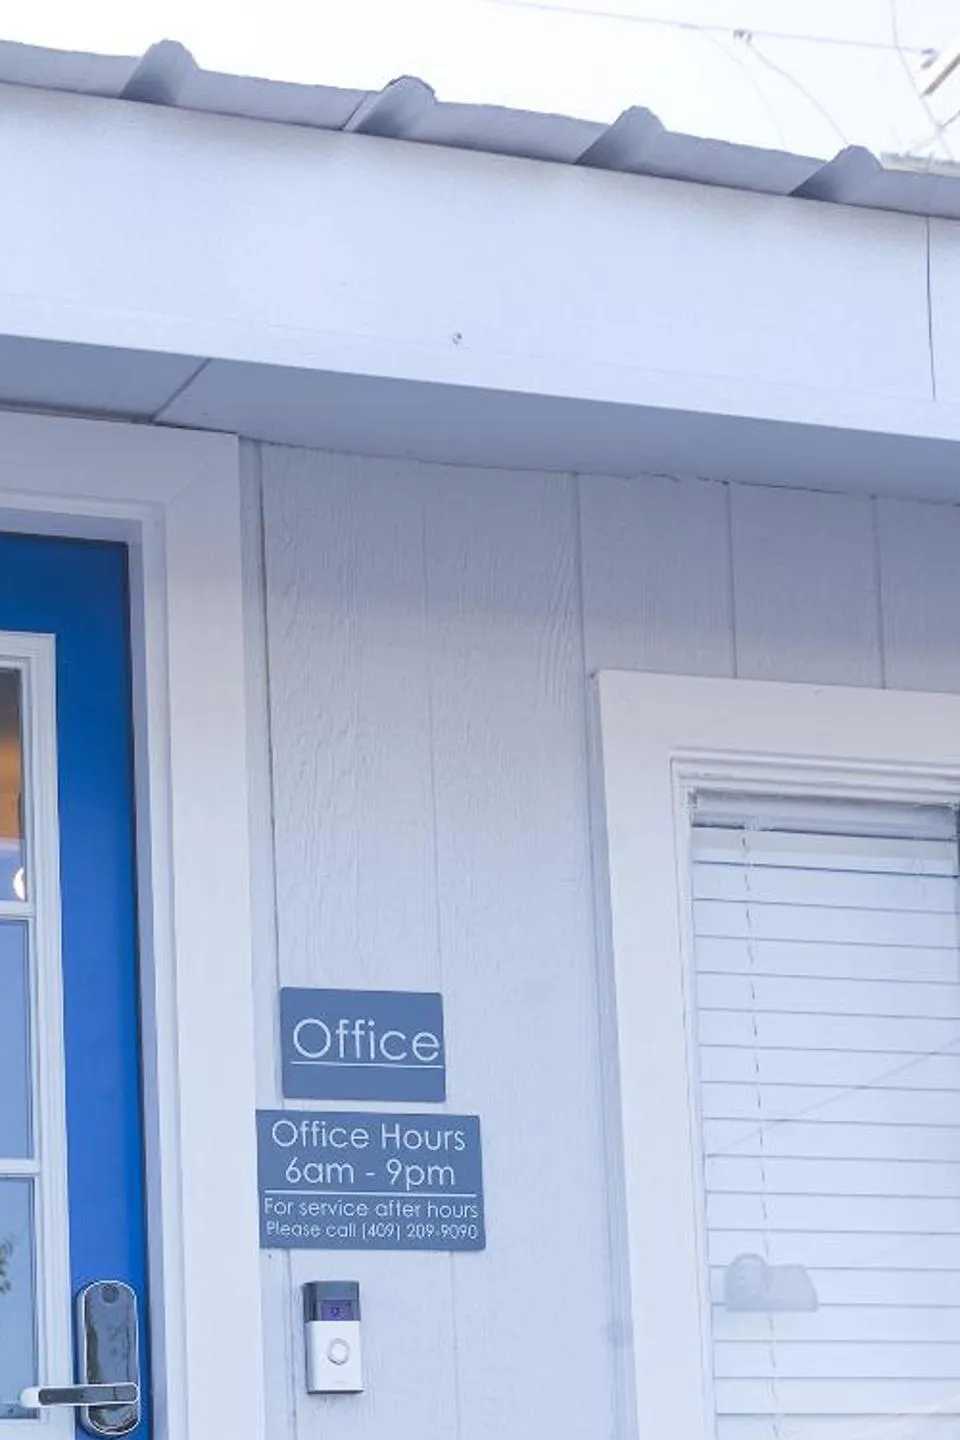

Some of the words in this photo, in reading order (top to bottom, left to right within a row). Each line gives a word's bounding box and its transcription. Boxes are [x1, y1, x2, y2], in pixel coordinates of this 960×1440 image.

[293, 1018, 440, 1062] Office
[272, 1119, 370, 1149] Office
[381, 1123, 466, 1151] Hours
[285, 1156, 354, 1184] 6am
[386, 1158, 455, 1191] 9pm
[264, 1198, 294, 1215] For
[299, 1199, 369, 1217] service
[375, 1199, 421, 1217] after
[427, 1200, 479, 1218] hours
[266, 1220, 321, 1237] Please
[326, 1222, 356, 1237] call
[362, 1223, 400, 1242] (409)
